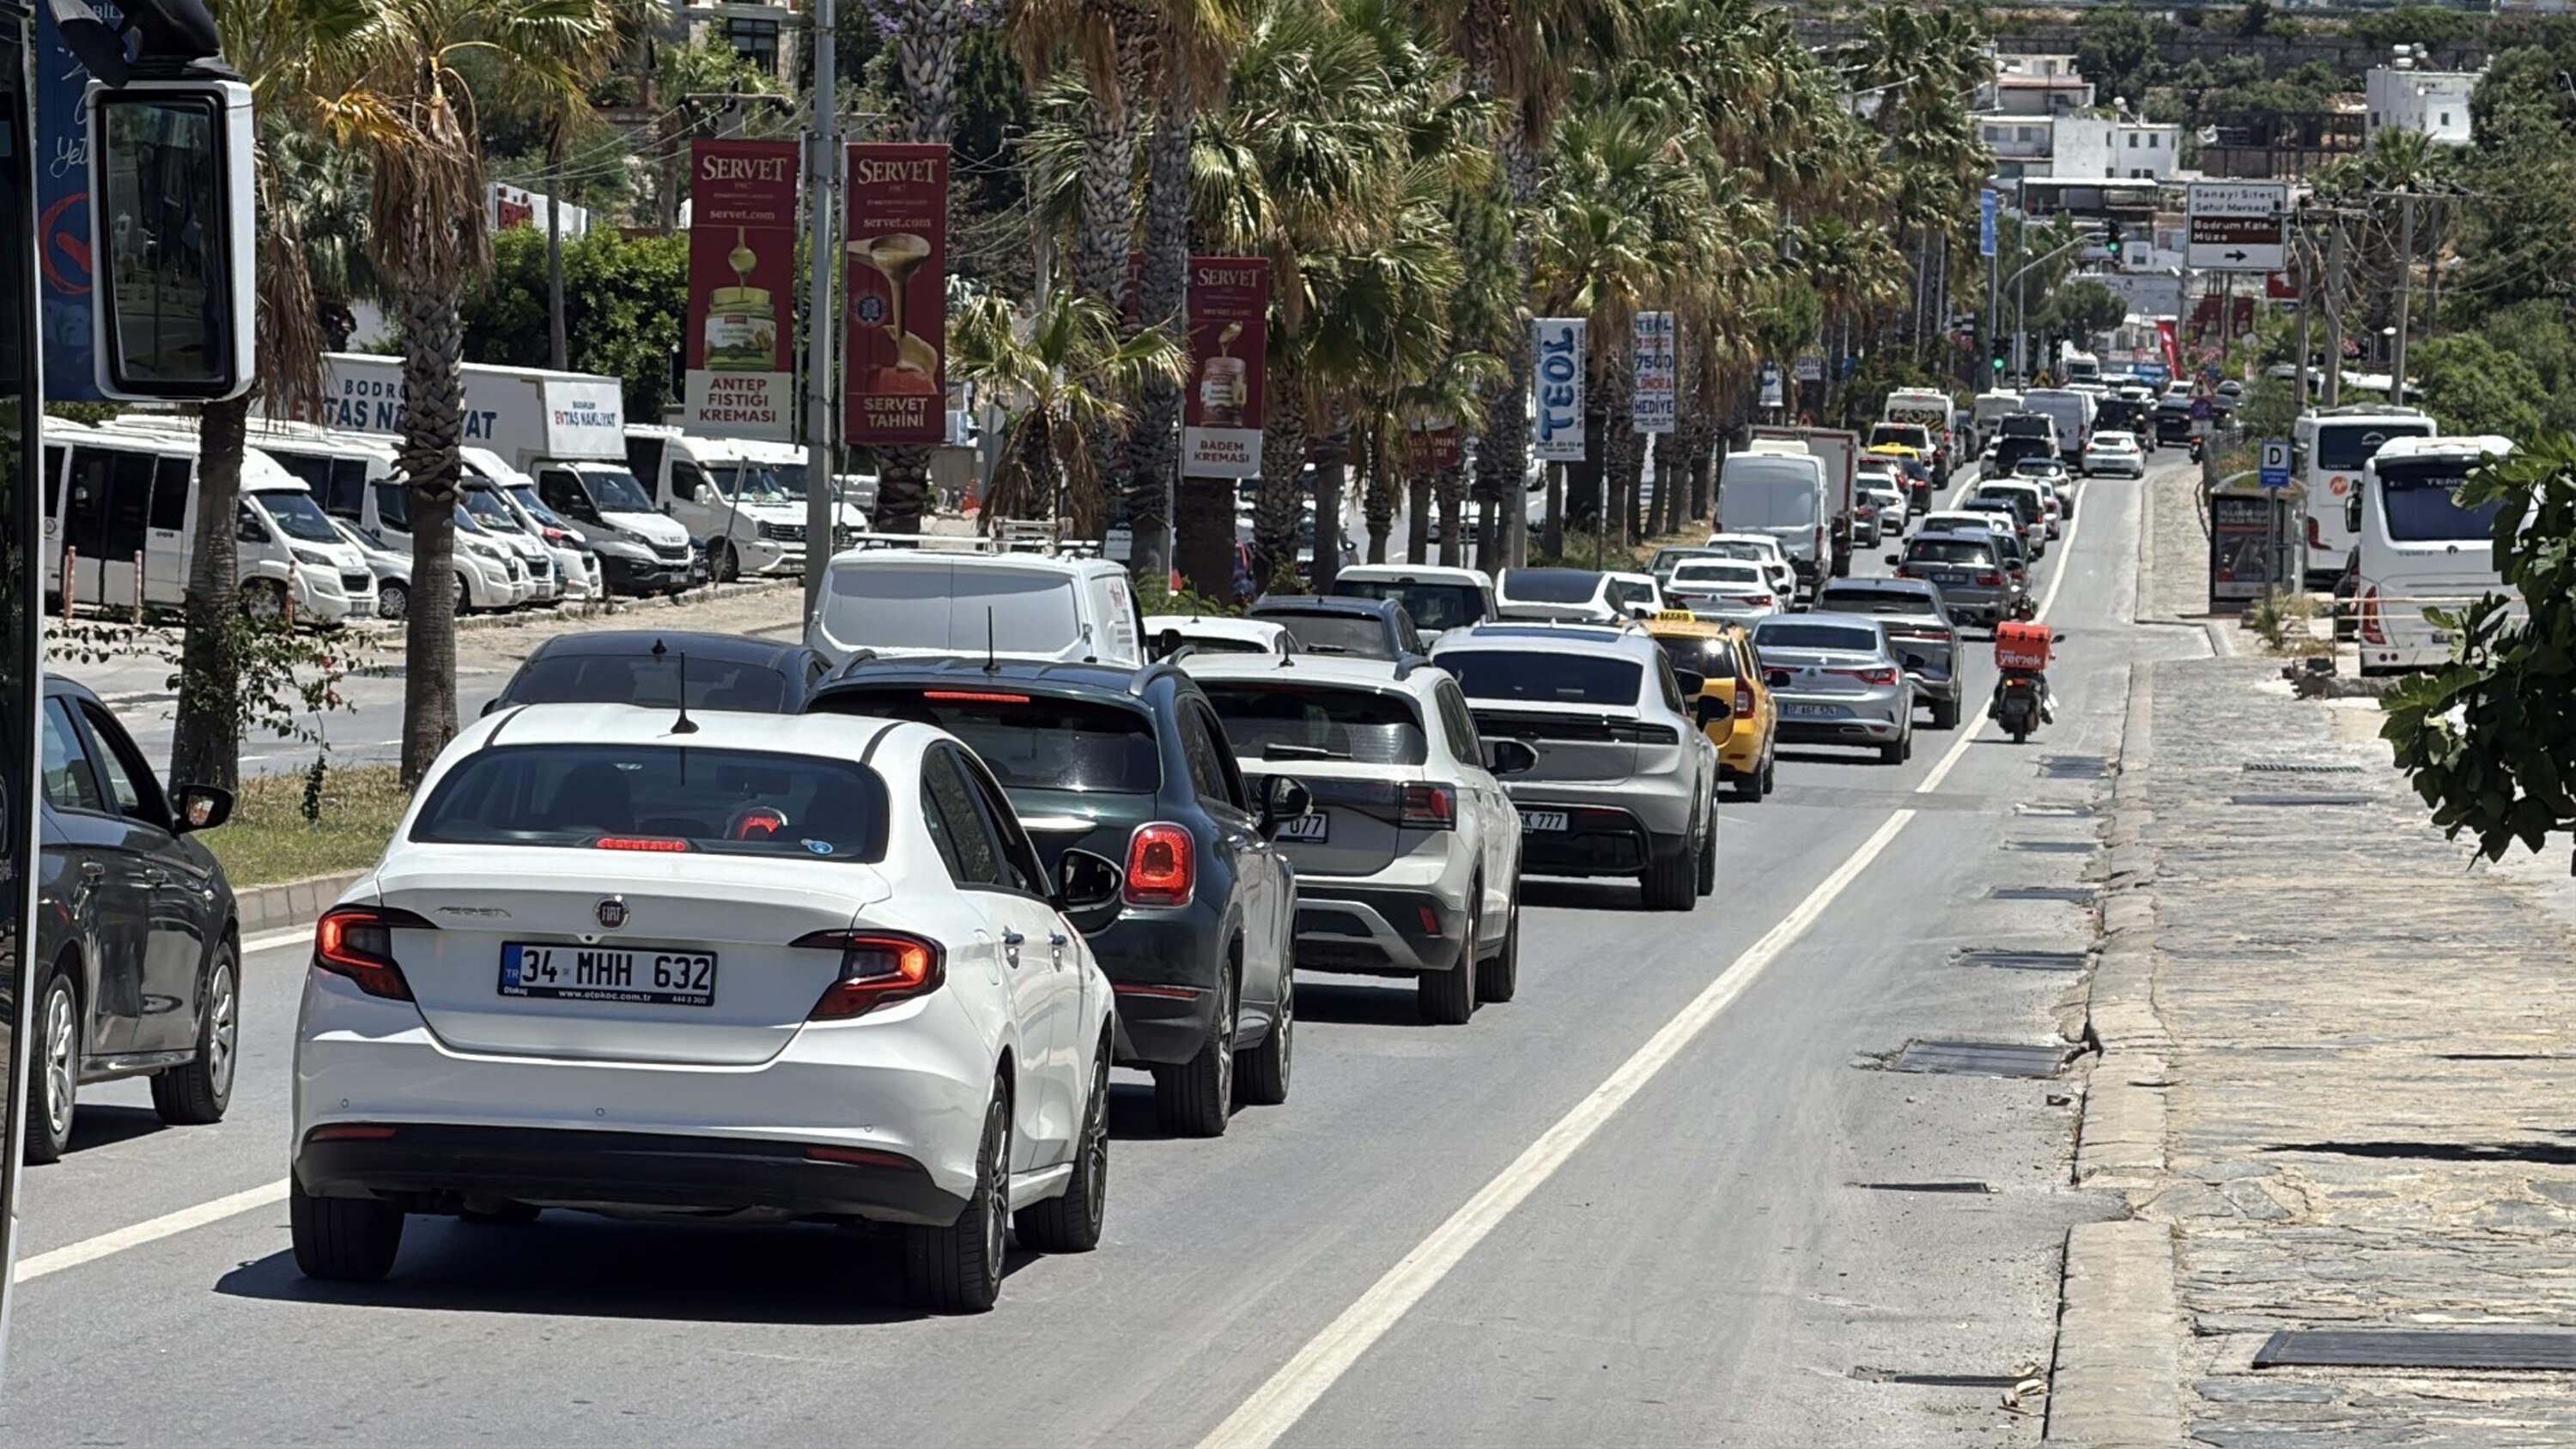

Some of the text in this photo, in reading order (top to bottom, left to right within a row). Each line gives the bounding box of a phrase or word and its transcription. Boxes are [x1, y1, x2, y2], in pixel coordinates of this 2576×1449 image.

[701, 155, 787, 182] SERVET
[858, 159, 939, 185] SERVET
[2195, 189, 2238, 200] Sanayi
[709, 210, 775, 220] servet.com
[864, 218, 932, 227] servet.com
[2194, 220, 2241, 230] Bodrum
[2194, 232, 2227, 241] Müze
[1197, 268, 1260, 288] SERVET
[1635, 355, 1673, 370] 7500
[710, 379, 767, 391] ANTEP
[1540, 327, 1575, 441] TEOL
[864, 397, 927, 411] SERVET
[1634, 396, 1673, 414] HEDİYE
[700, 409, 776, 422] KREMASI
[868, 411, 924, 427] TAHİNİ
[1200, 440, 1244, 451] BADEM
[1194, 452, 1249, 463] KREMASI
[2269, 447, 2281, 464] D
[1999, 654, 2042, 665] yemek
[1538, 813, 1563, 829] 777
[602, 905, 622, 922] FIAT
[506, 968, 519, 979] TR
[522, 949, 711, 991] 34 MHH 632
